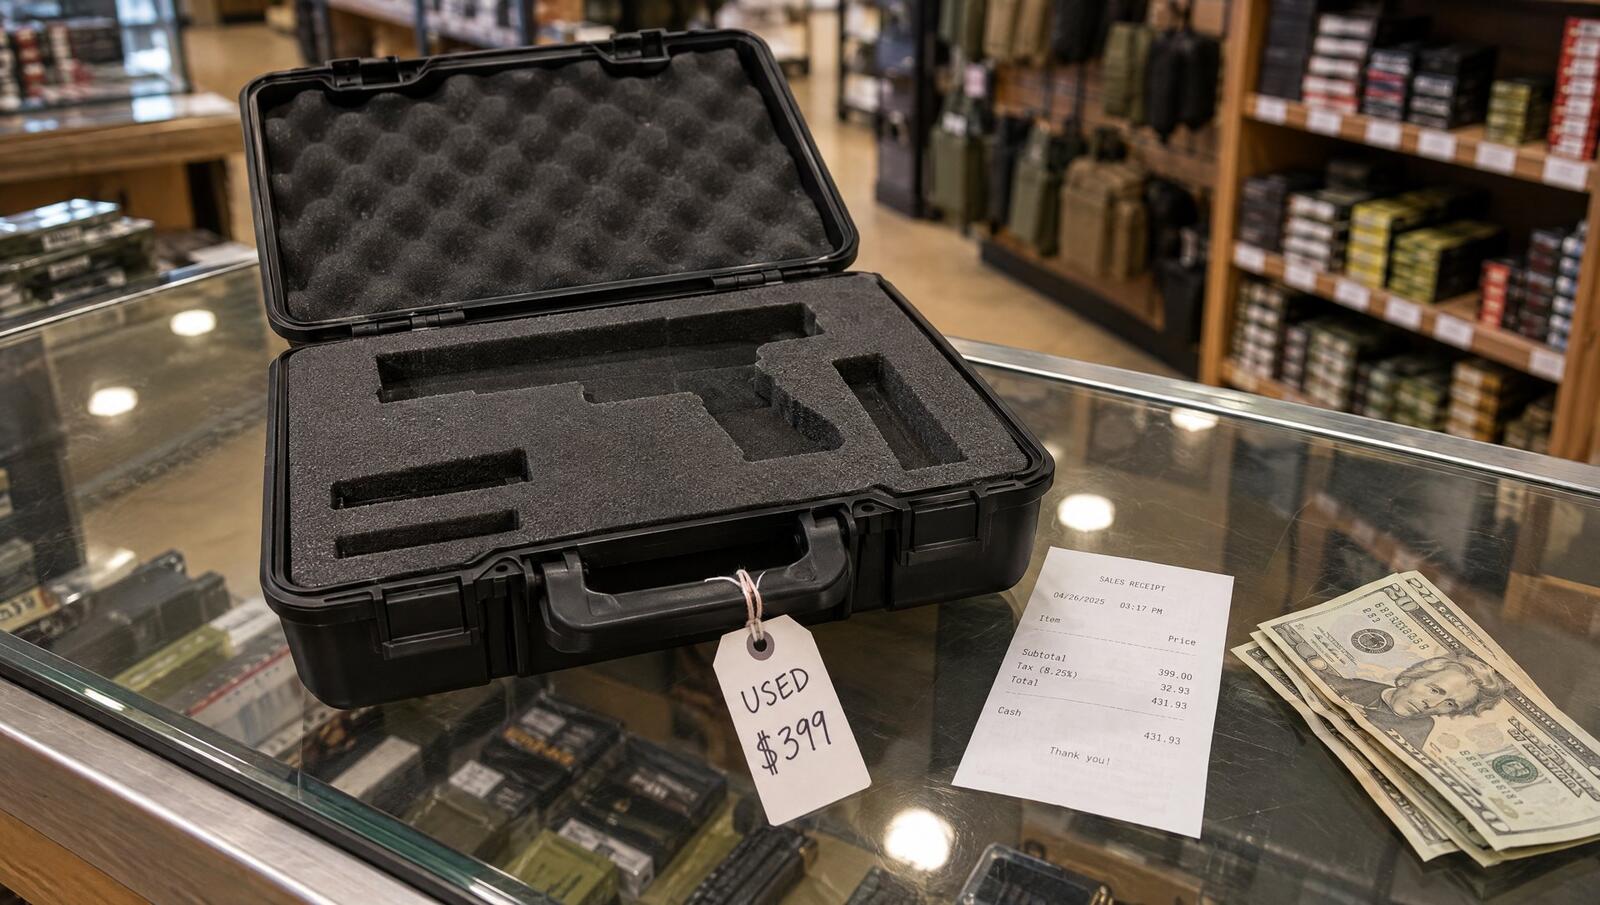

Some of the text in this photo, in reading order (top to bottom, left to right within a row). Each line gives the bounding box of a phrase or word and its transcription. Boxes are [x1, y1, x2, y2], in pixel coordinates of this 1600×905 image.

[1099, 575, 1167, 592] SALES RECEIPT
[1053, 591, 1163, 615] 04/26/2025 03:17 PM
[1039, 614, 1197, 646] Item Price
[1016, 661, 1190, 695] Tax (8.25%) 32.93
[1021, 648, 1193, 681] Subtotal 399.00
[740, 667, 809, 714] USED
[1011, 675, 1188, 710] Total 431.93
[997, 705, 1181, 745] Cash 431.93
[756, 710, 832, 776] $399
[1050, 746, 1111, 767] Thank you!
